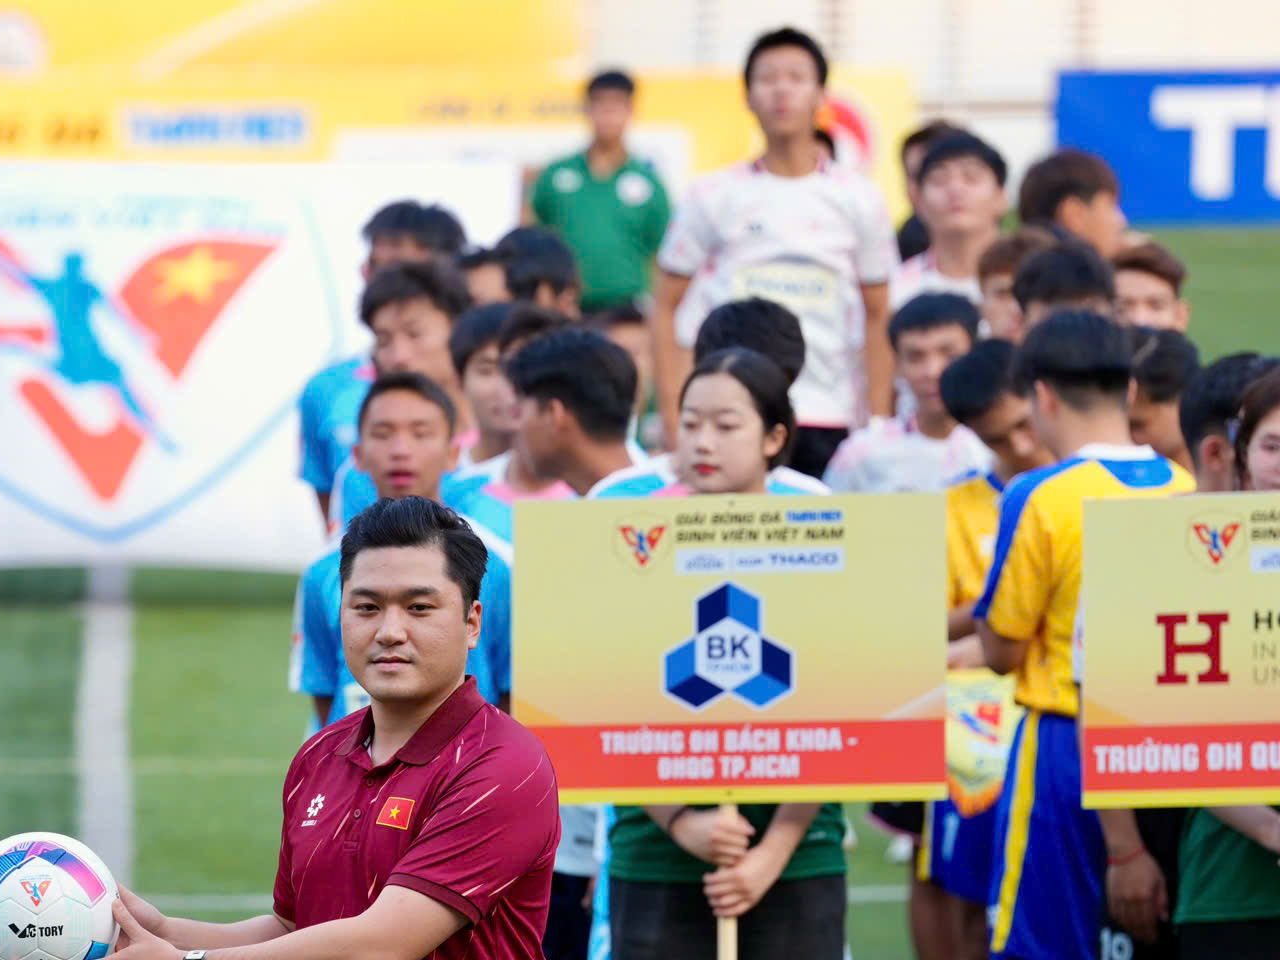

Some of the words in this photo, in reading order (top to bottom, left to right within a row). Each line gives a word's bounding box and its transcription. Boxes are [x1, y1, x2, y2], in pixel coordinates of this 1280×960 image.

[1150, 84, 1280, 201] T
[805, 528, 844, 541] NAM
[769, 552, 838, 566] THACO
[1254, 611, 1280, 630] H
[707, 635, 750, 659] BK
[786, 727, 843, 751] KHOA
[1094, 737, 1200, 774] TRƯỜNG
[1207, 742, 1242, 771] ĐH
